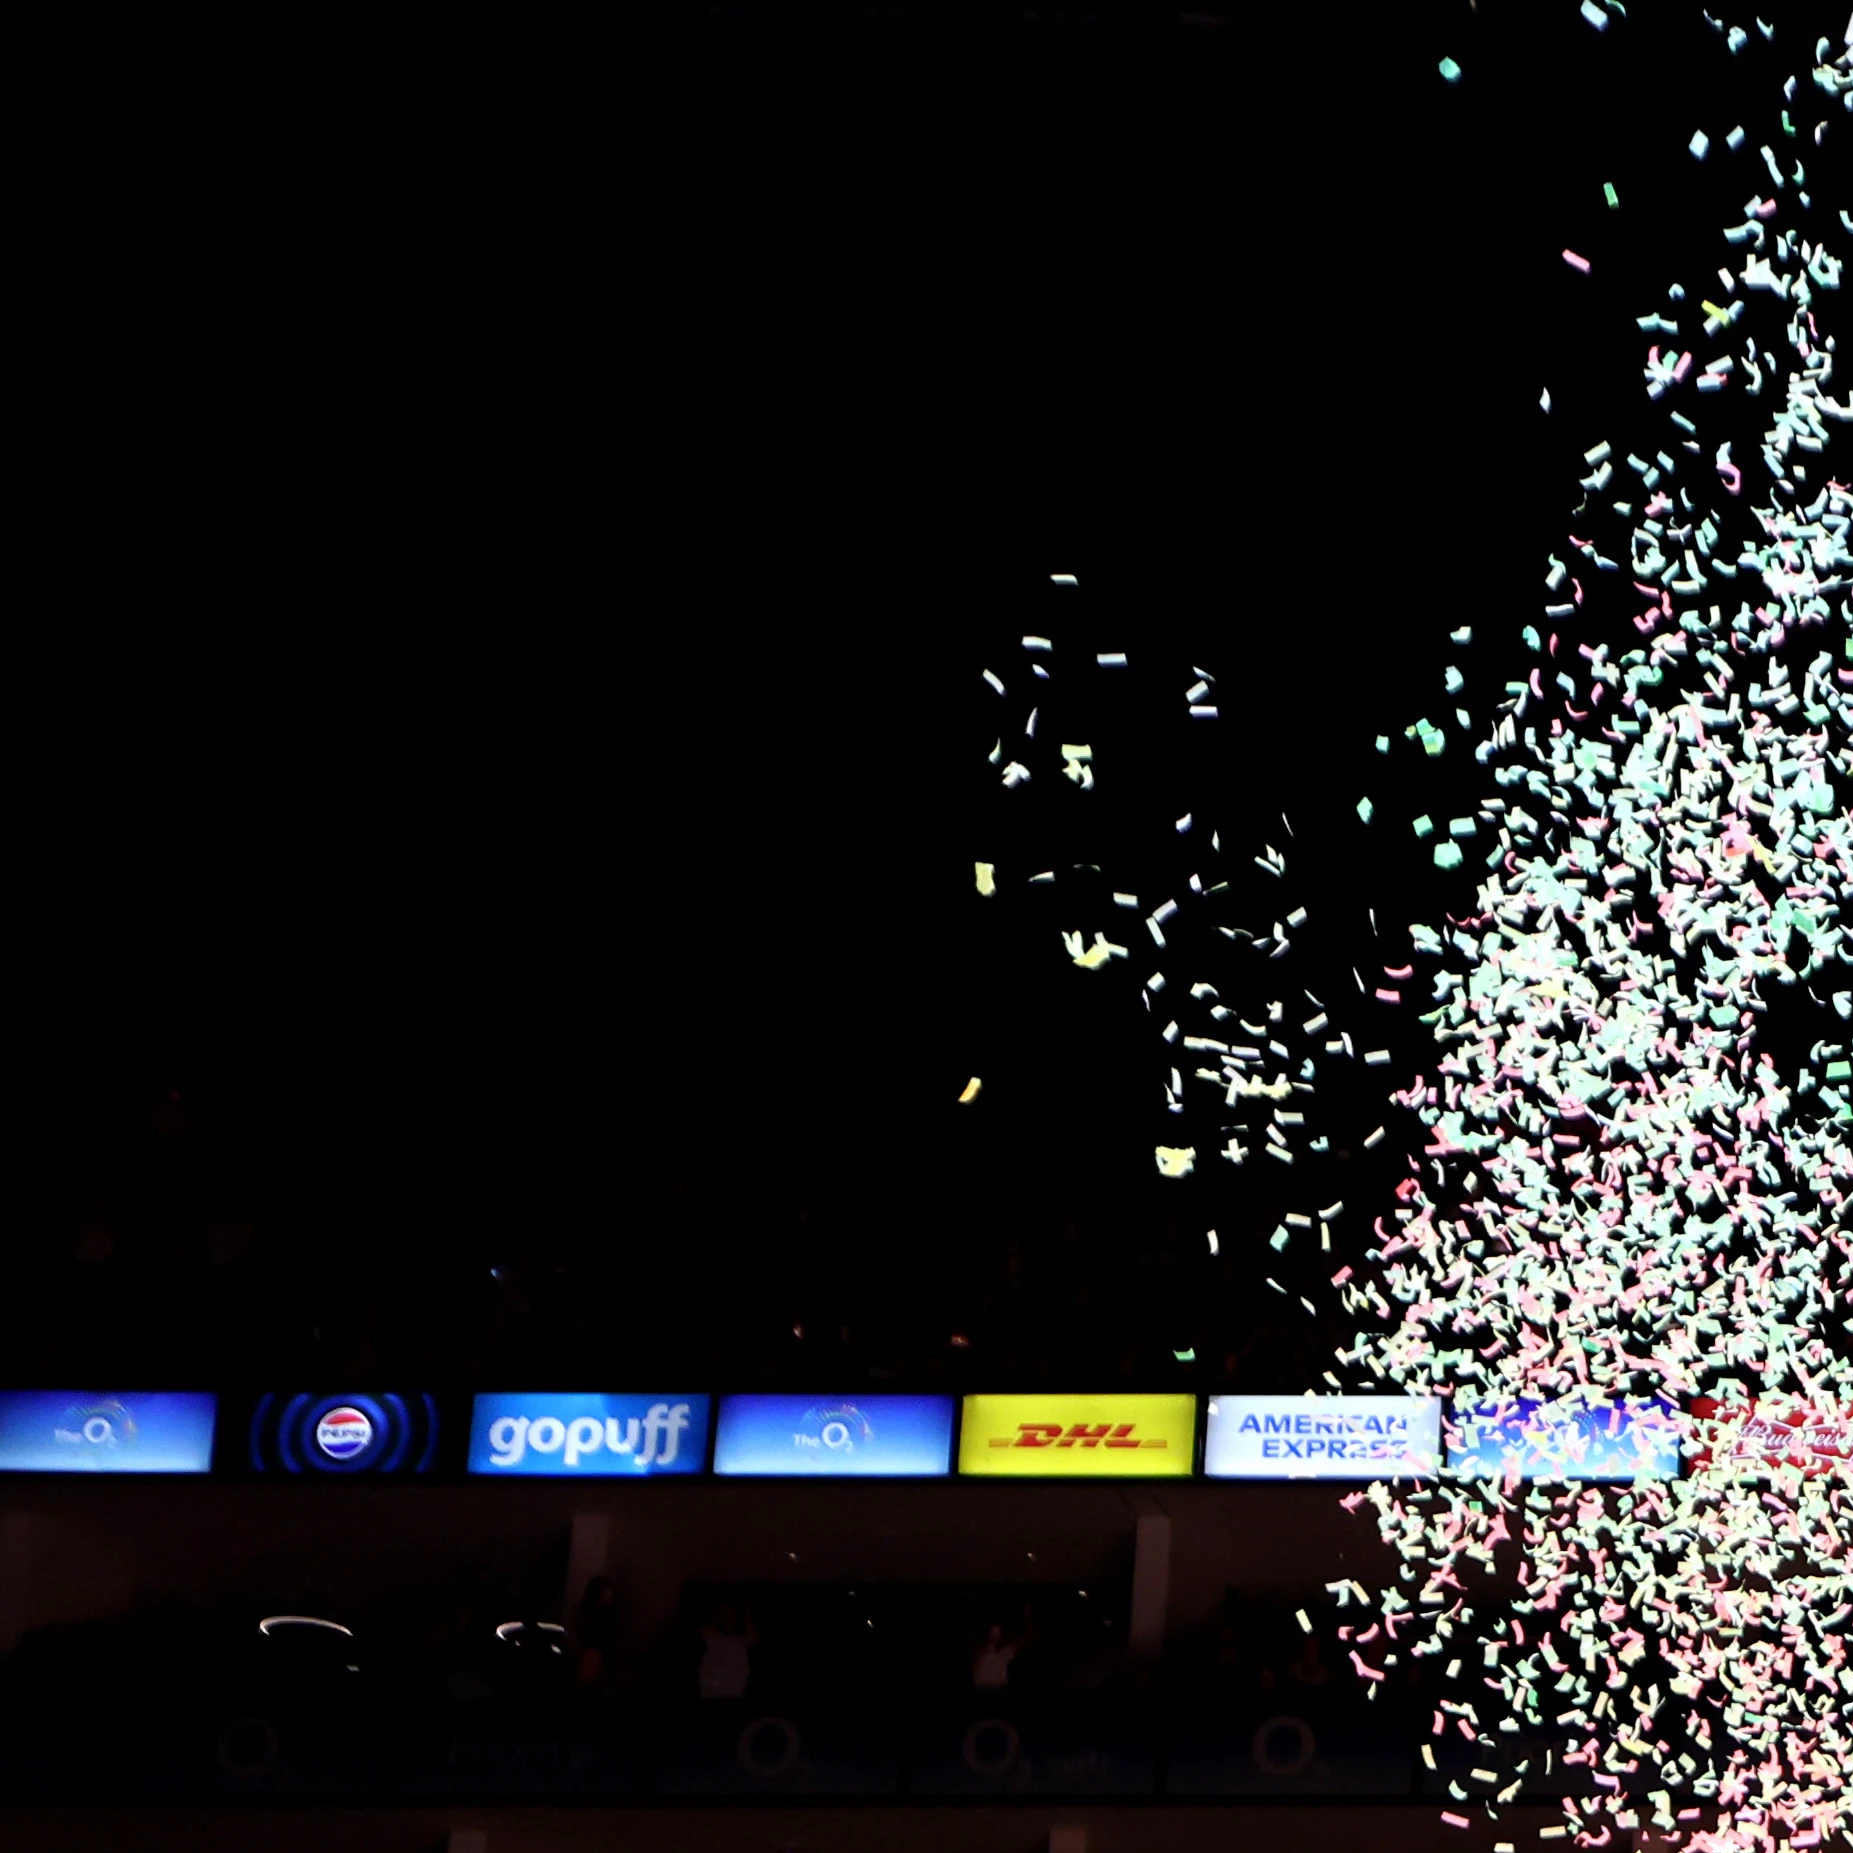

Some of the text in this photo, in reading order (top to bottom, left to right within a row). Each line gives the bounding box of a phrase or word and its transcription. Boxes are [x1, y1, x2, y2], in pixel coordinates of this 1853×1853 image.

[489, 1403, 689, 1467] gopuff
[1238, 1413, 1408, 1434] AMERICAN
[792, 1432, 821, 1448] The
[1013, 1423, 1143, 1448] DHL
